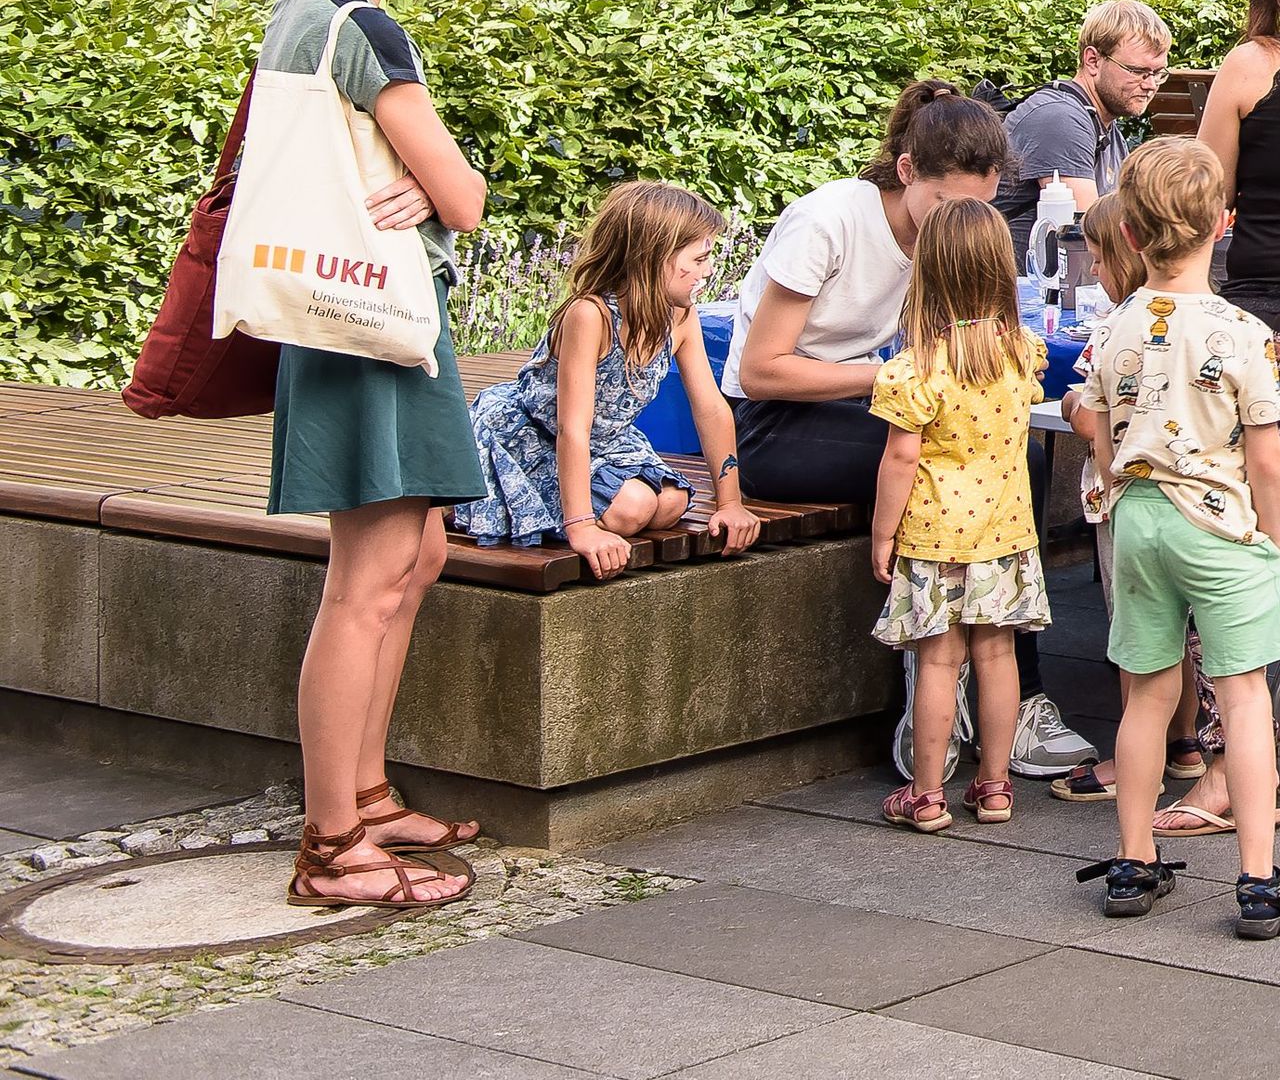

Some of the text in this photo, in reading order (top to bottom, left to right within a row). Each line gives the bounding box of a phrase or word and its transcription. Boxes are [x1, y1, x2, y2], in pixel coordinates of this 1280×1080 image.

[316, 253, 389, 290] UKH
[306, 304, 386, 331] Halle (Saale)
